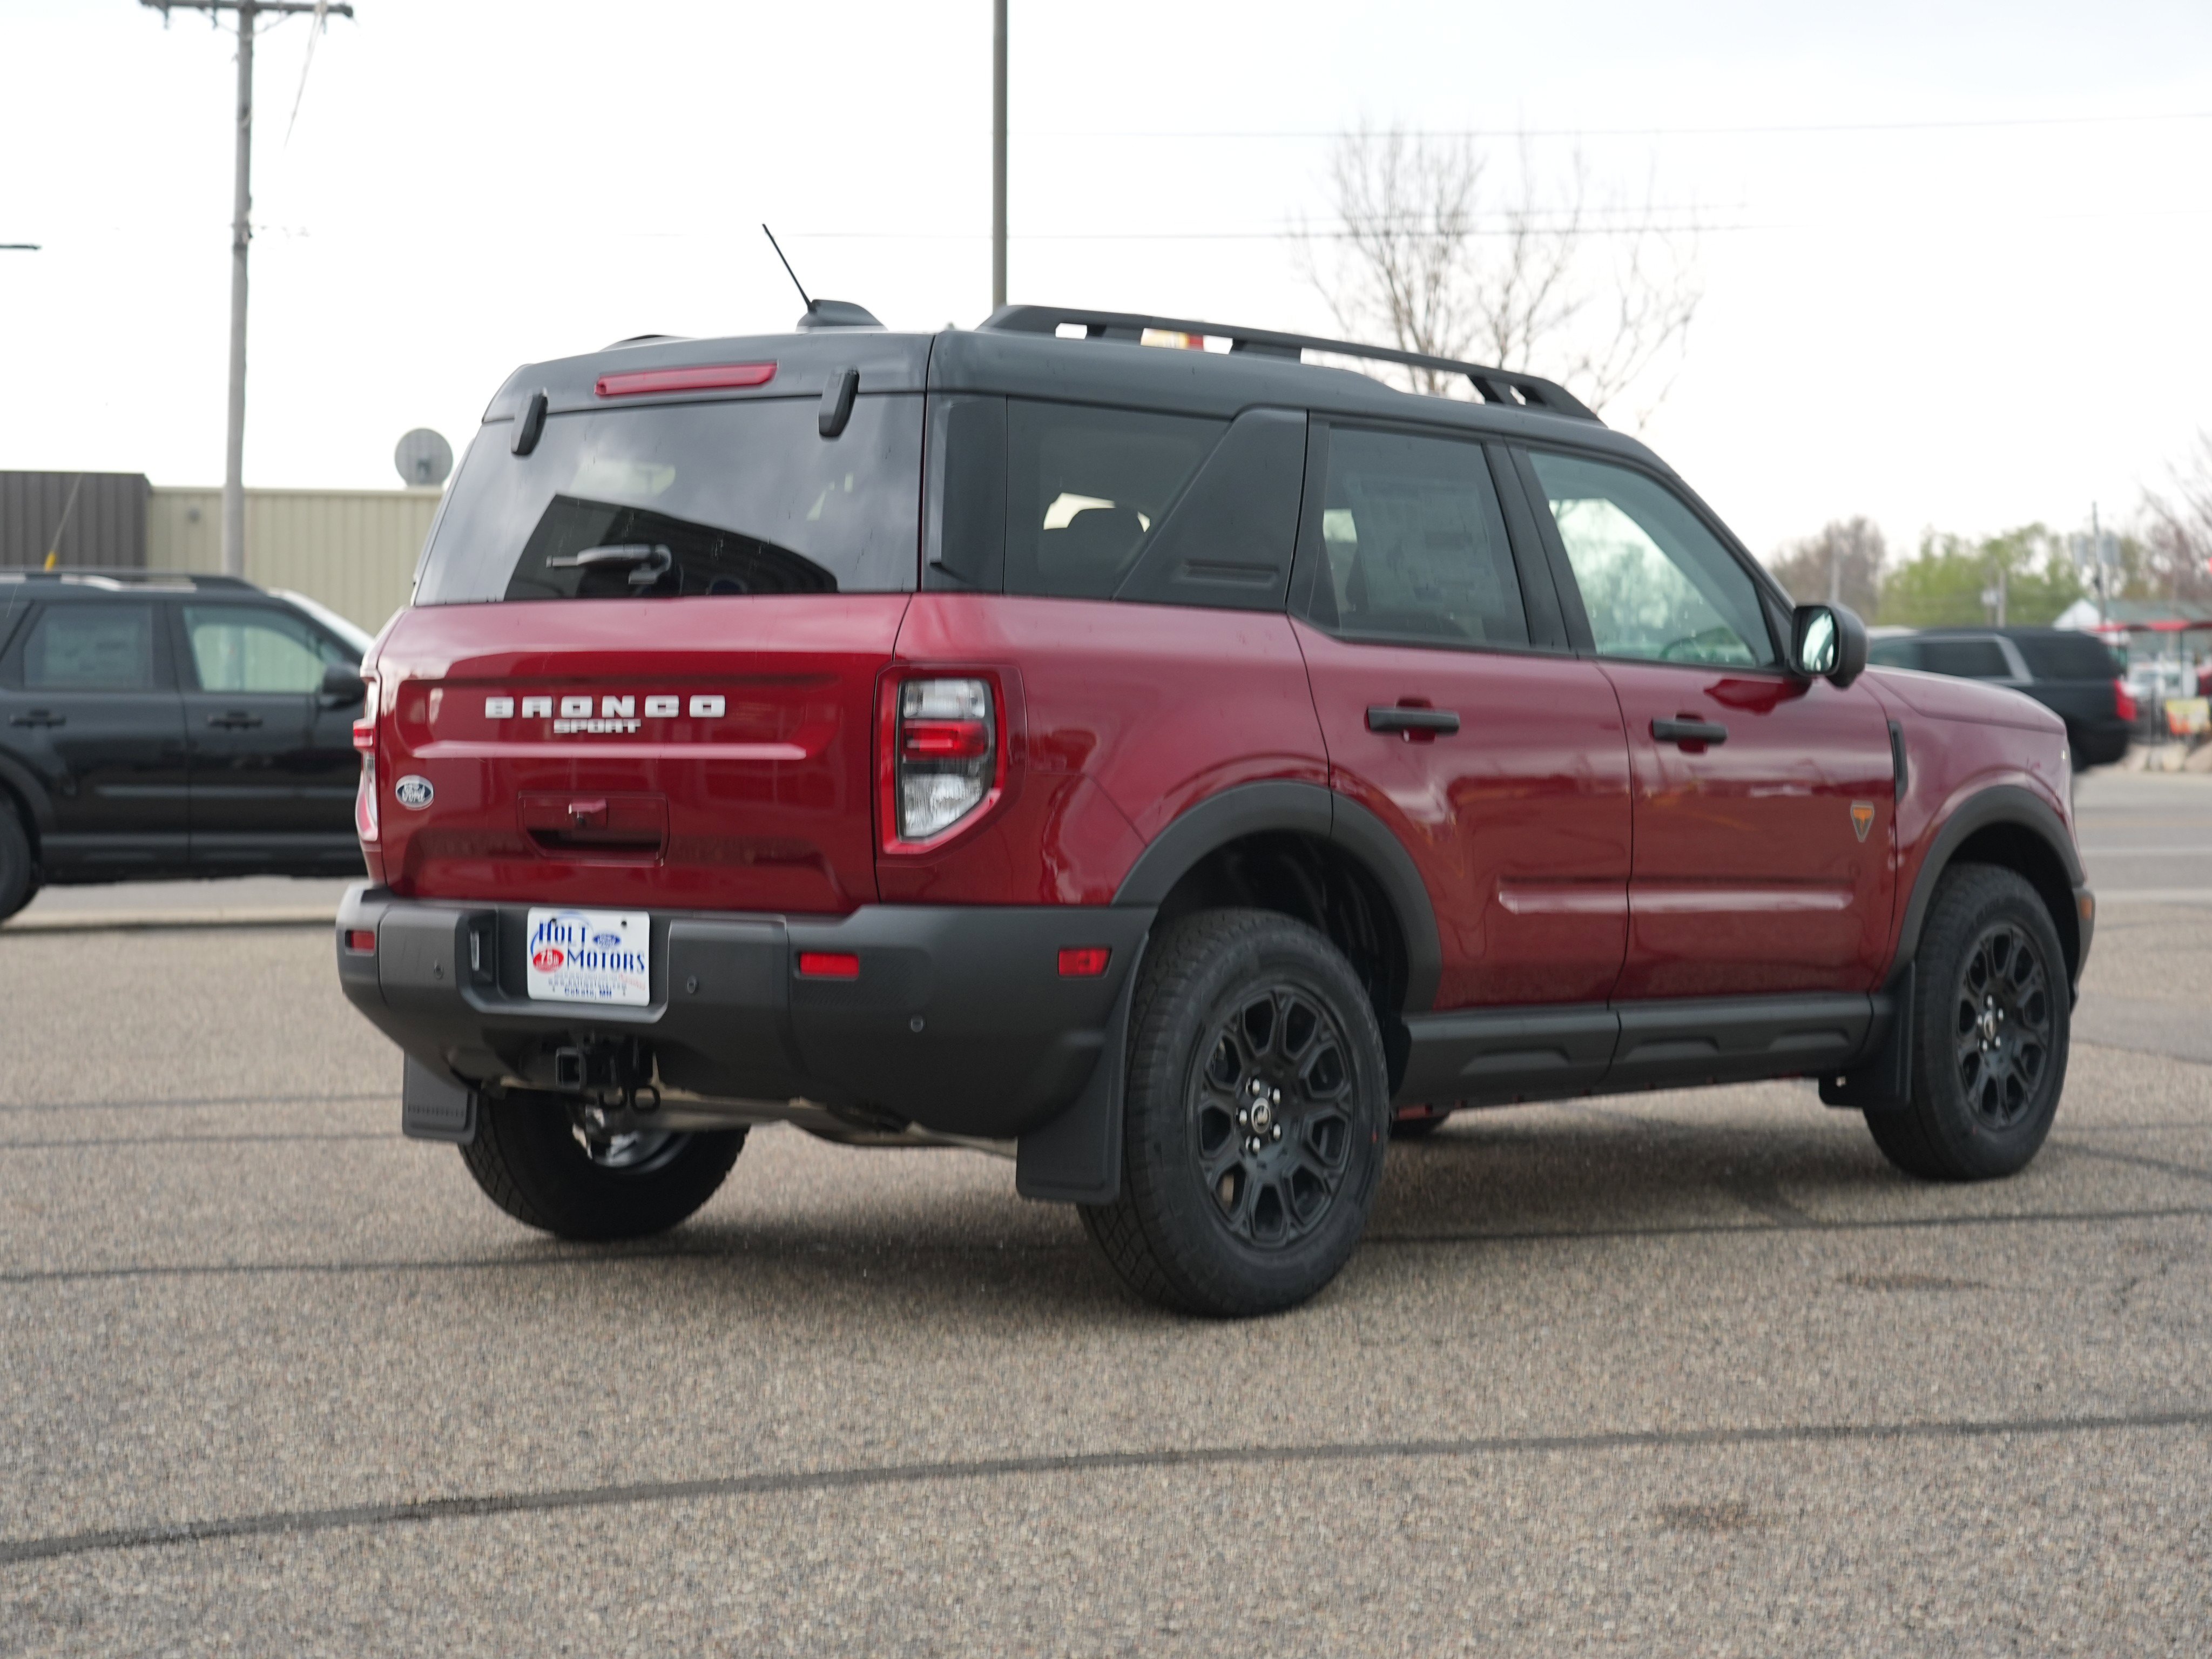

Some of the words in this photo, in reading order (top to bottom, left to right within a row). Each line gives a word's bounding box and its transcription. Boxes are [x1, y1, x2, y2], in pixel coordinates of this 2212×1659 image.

[485, 694, 725, 718] BRONCO
[554, 718, 642, 733] SPORT
[538, 921, 588, 946] HOLT
[567, 948, 645, 973] MOTORS
